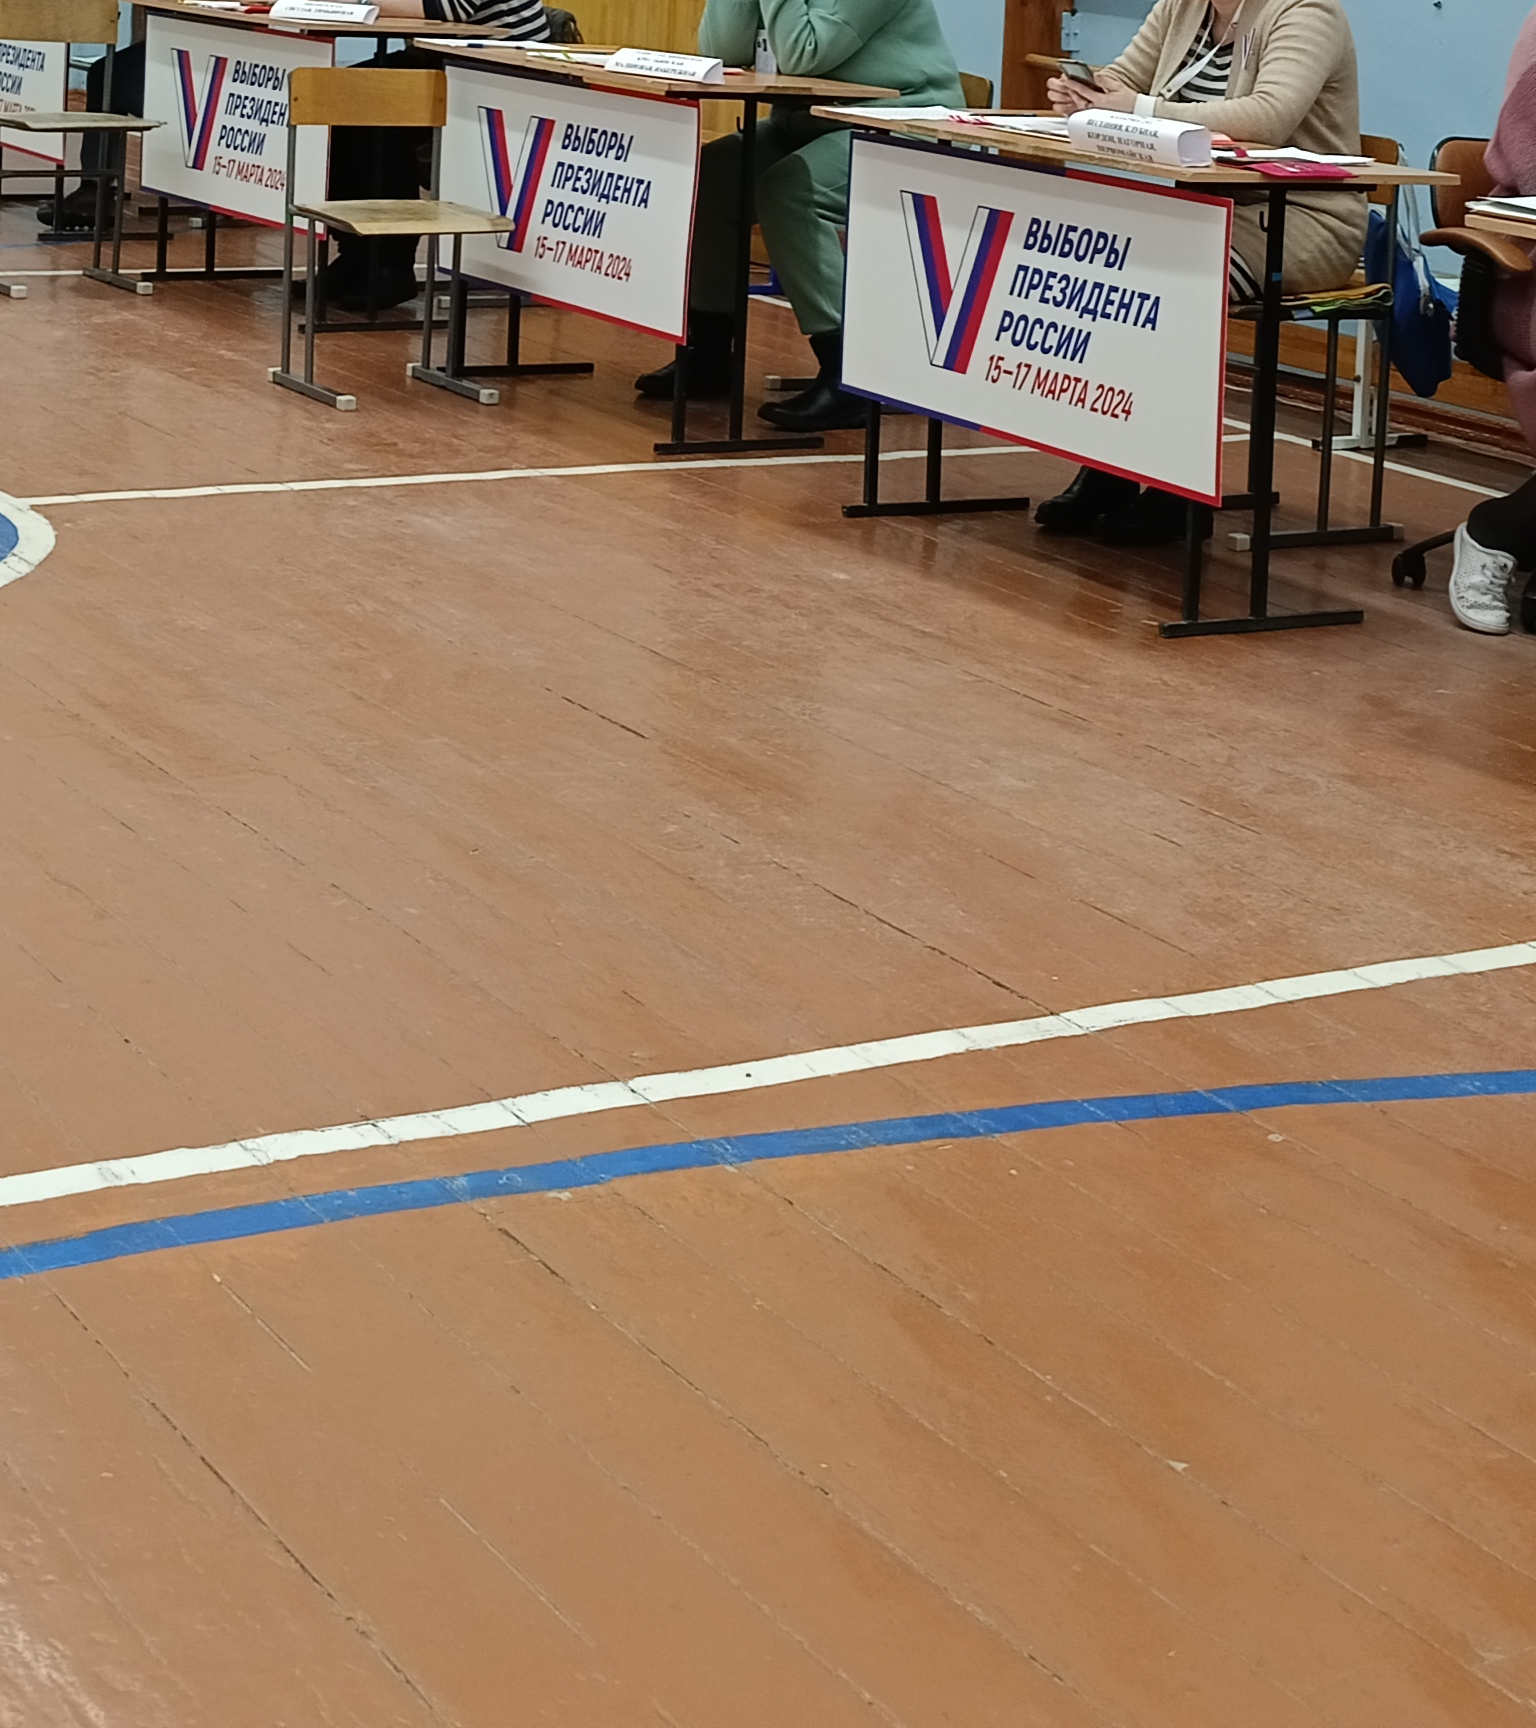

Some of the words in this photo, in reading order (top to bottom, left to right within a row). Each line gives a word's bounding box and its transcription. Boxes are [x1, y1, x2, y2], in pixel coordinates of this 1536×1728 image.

[232, 60, 287, 92] ВЫБОРЫ
[224, 92, 290, 128] ПРЕЗИДЕН
[217, 124, 267, 156] РОССИИ
[561, 123, 635, 163] ВЫБОРЫ
[235, 161, 265, 186] МАРТА
[550, 161, 653, 209] ПРЕЗИДЕНТА
[541, 198, 607, 239] РОССИИ
[564, 242, 603, 275] МАРТА
[604, 253, 633, 283] 2024
[1022, 216, 1132, 271] ВЫБОРЫ
[1008, 263, 1162, 332] ПРЕЗИДЕНТА
[994, 309, 1093, 365] РОССИИ
[1030, 366, 1091, 409] МАРТА
[1089, 383, 1135, 423] 2024
